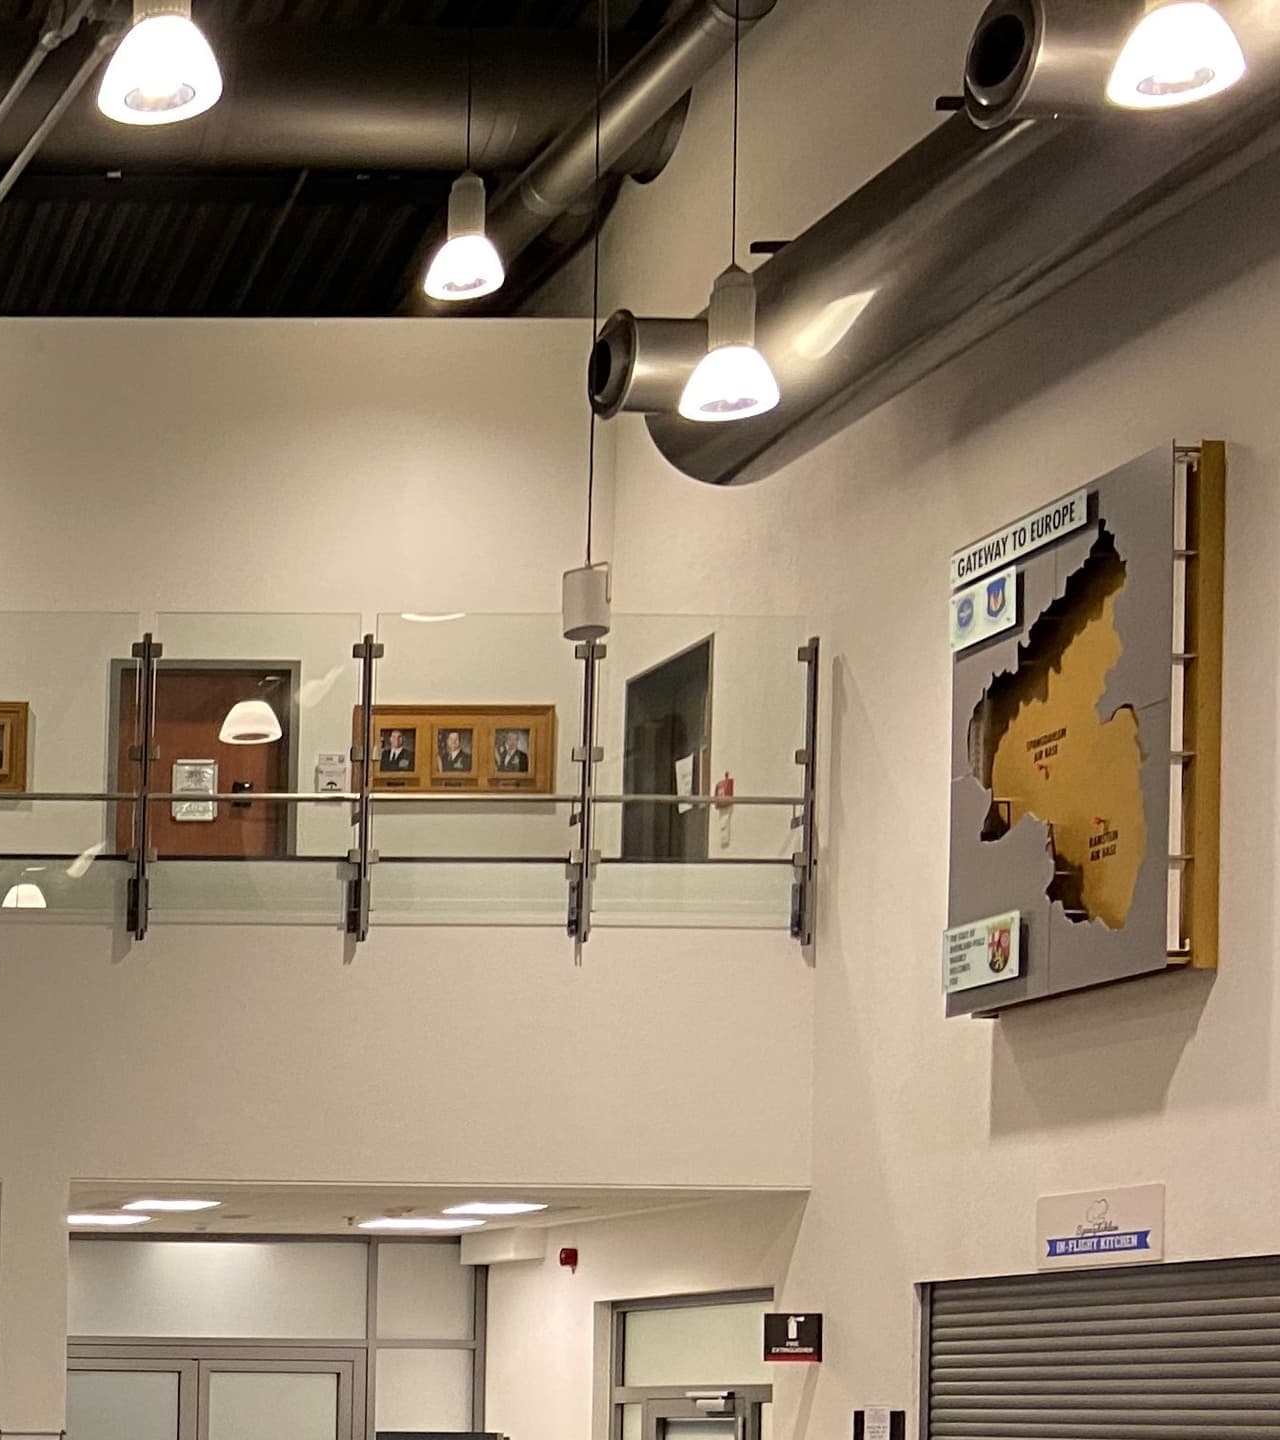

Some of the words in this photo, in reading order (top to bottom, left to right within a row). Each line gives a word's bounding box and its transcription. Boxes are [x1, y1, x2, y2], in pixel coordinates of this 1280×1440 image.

[957, 535, 1009, 578] GATEWAY
[1012, 528, 1027, 551] TO
[1030, 501, 1076, 542] EUROPE
[1055, 1238, 1097, 1254] IN-FLIGHT
[1099, 1234, 1138, 1251] KITCHEN
